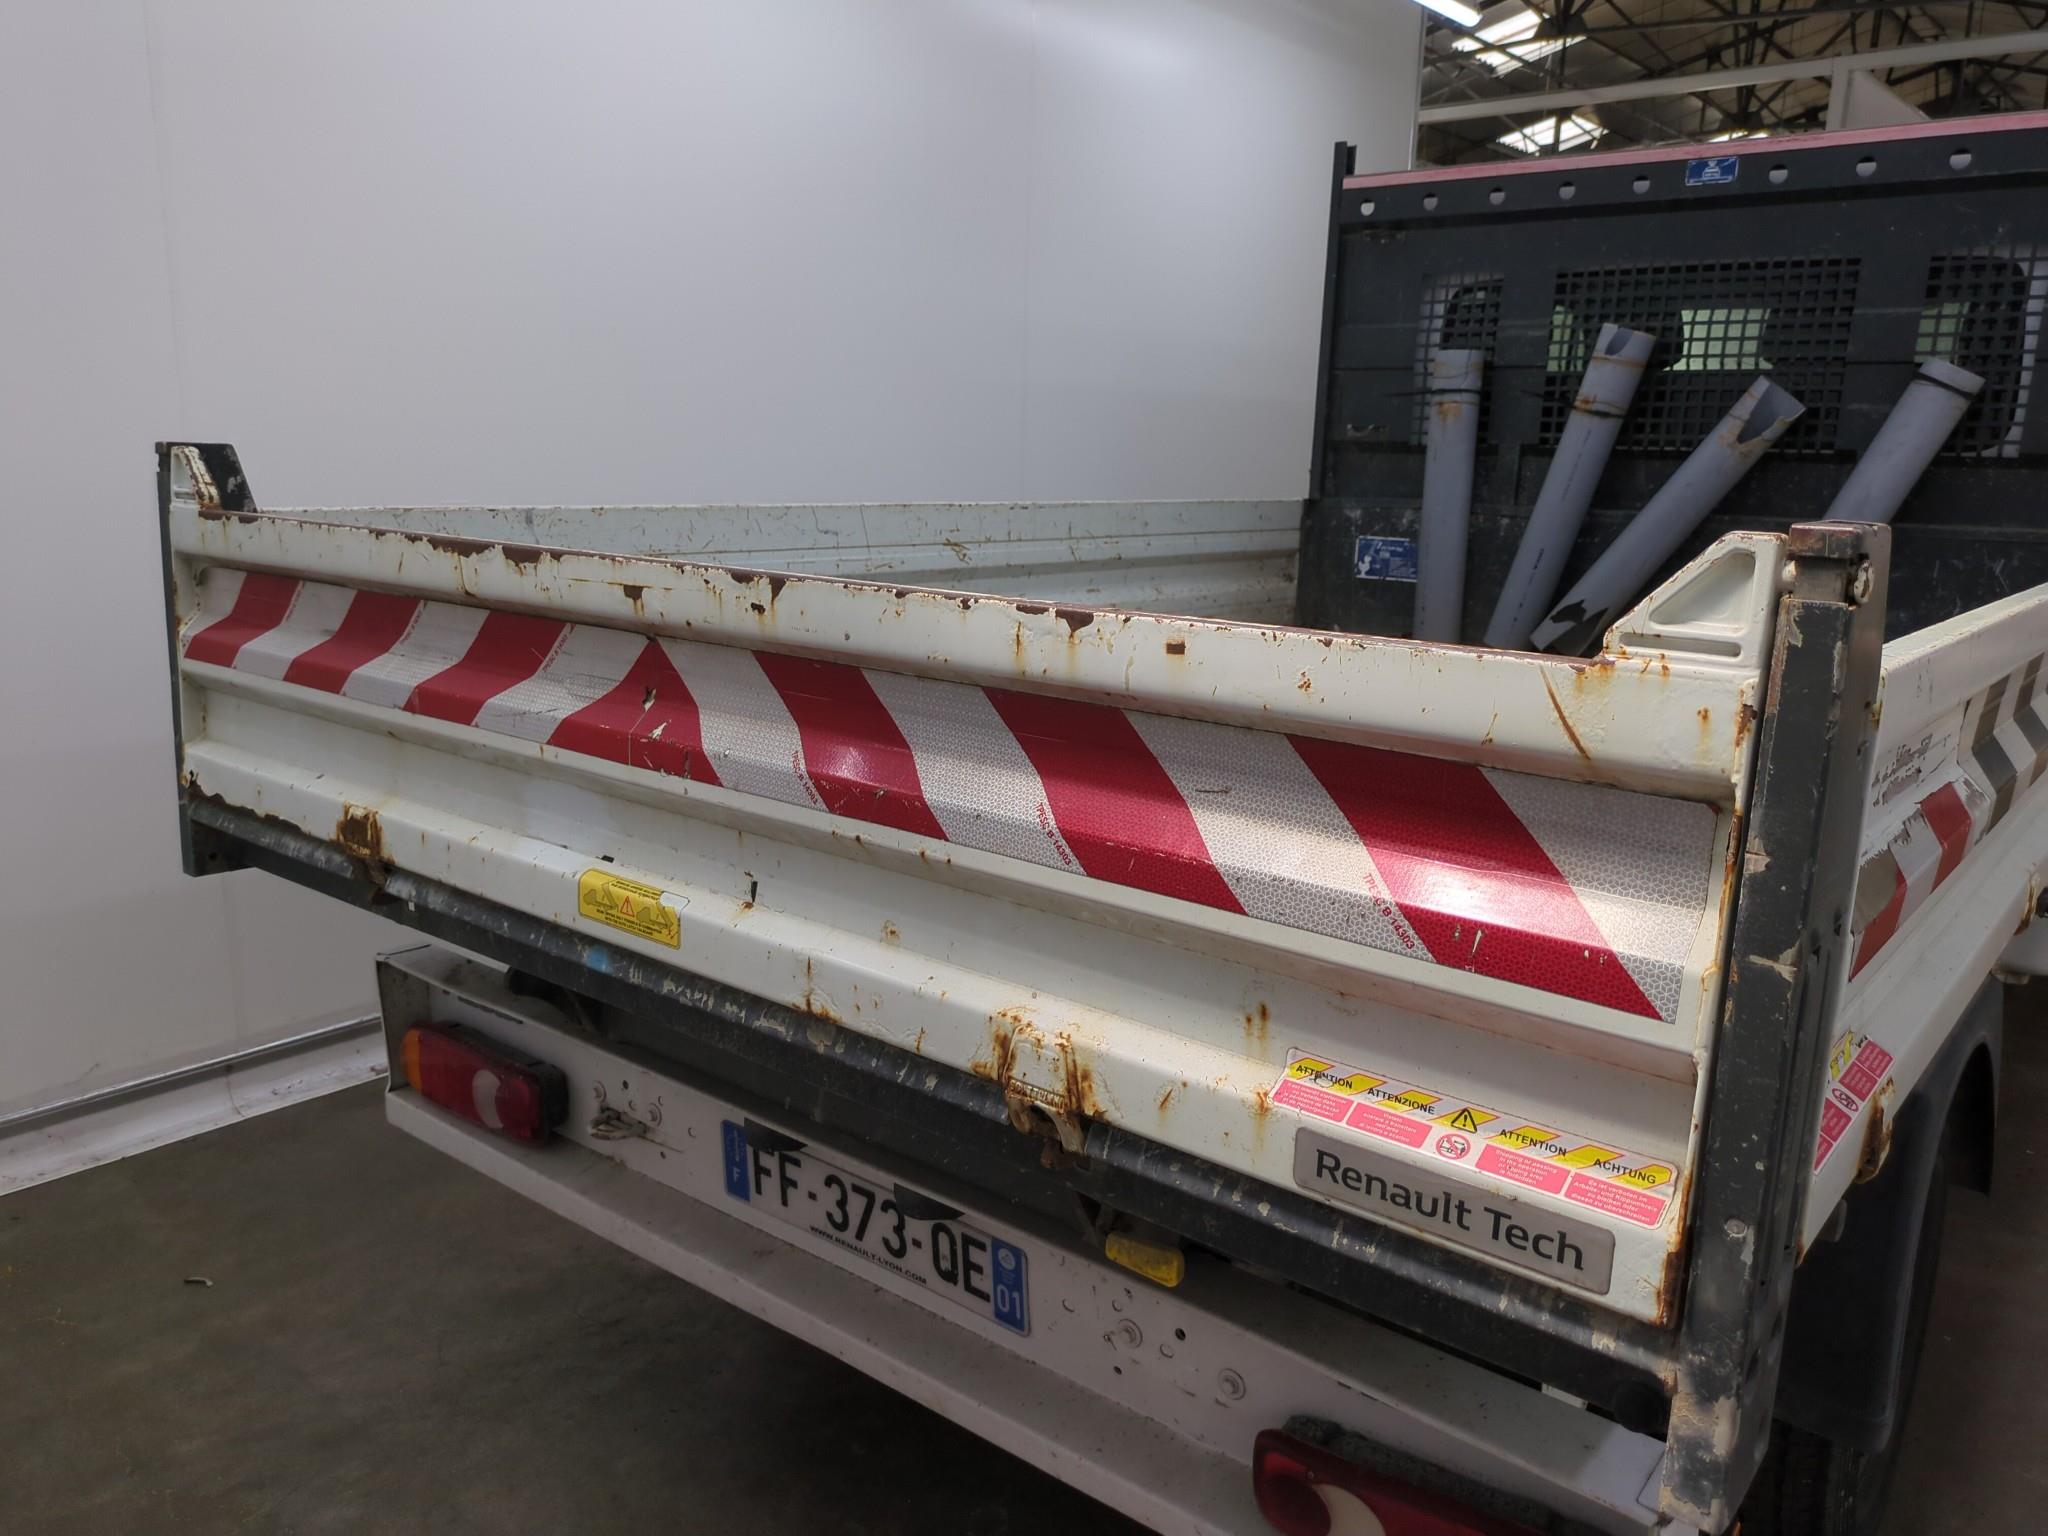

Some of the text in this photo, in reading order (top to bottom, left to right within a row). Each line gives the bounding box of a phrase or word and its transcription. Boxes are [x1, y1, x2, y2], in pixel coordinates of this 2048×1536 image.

[1382, 905, 1393, 917] B
[1390, 917, 1416, 950] 14303
[1296, 1064, 1353, 1089] ATTENTION
[1367, 1087, 1436, 1115] ATTENZIONE
[1499, 1128, 1567, 1157] ATTENTION
[732, 1167, 742, 1183] F
[1593, 1158, 1657, 1184] ACHTUNG
[1315, 1148, 1585, 1272] Renault Tech
[752, 1149, 991, 1304] FF-373-QE
[996, 1283, 1021, 1320] 01
